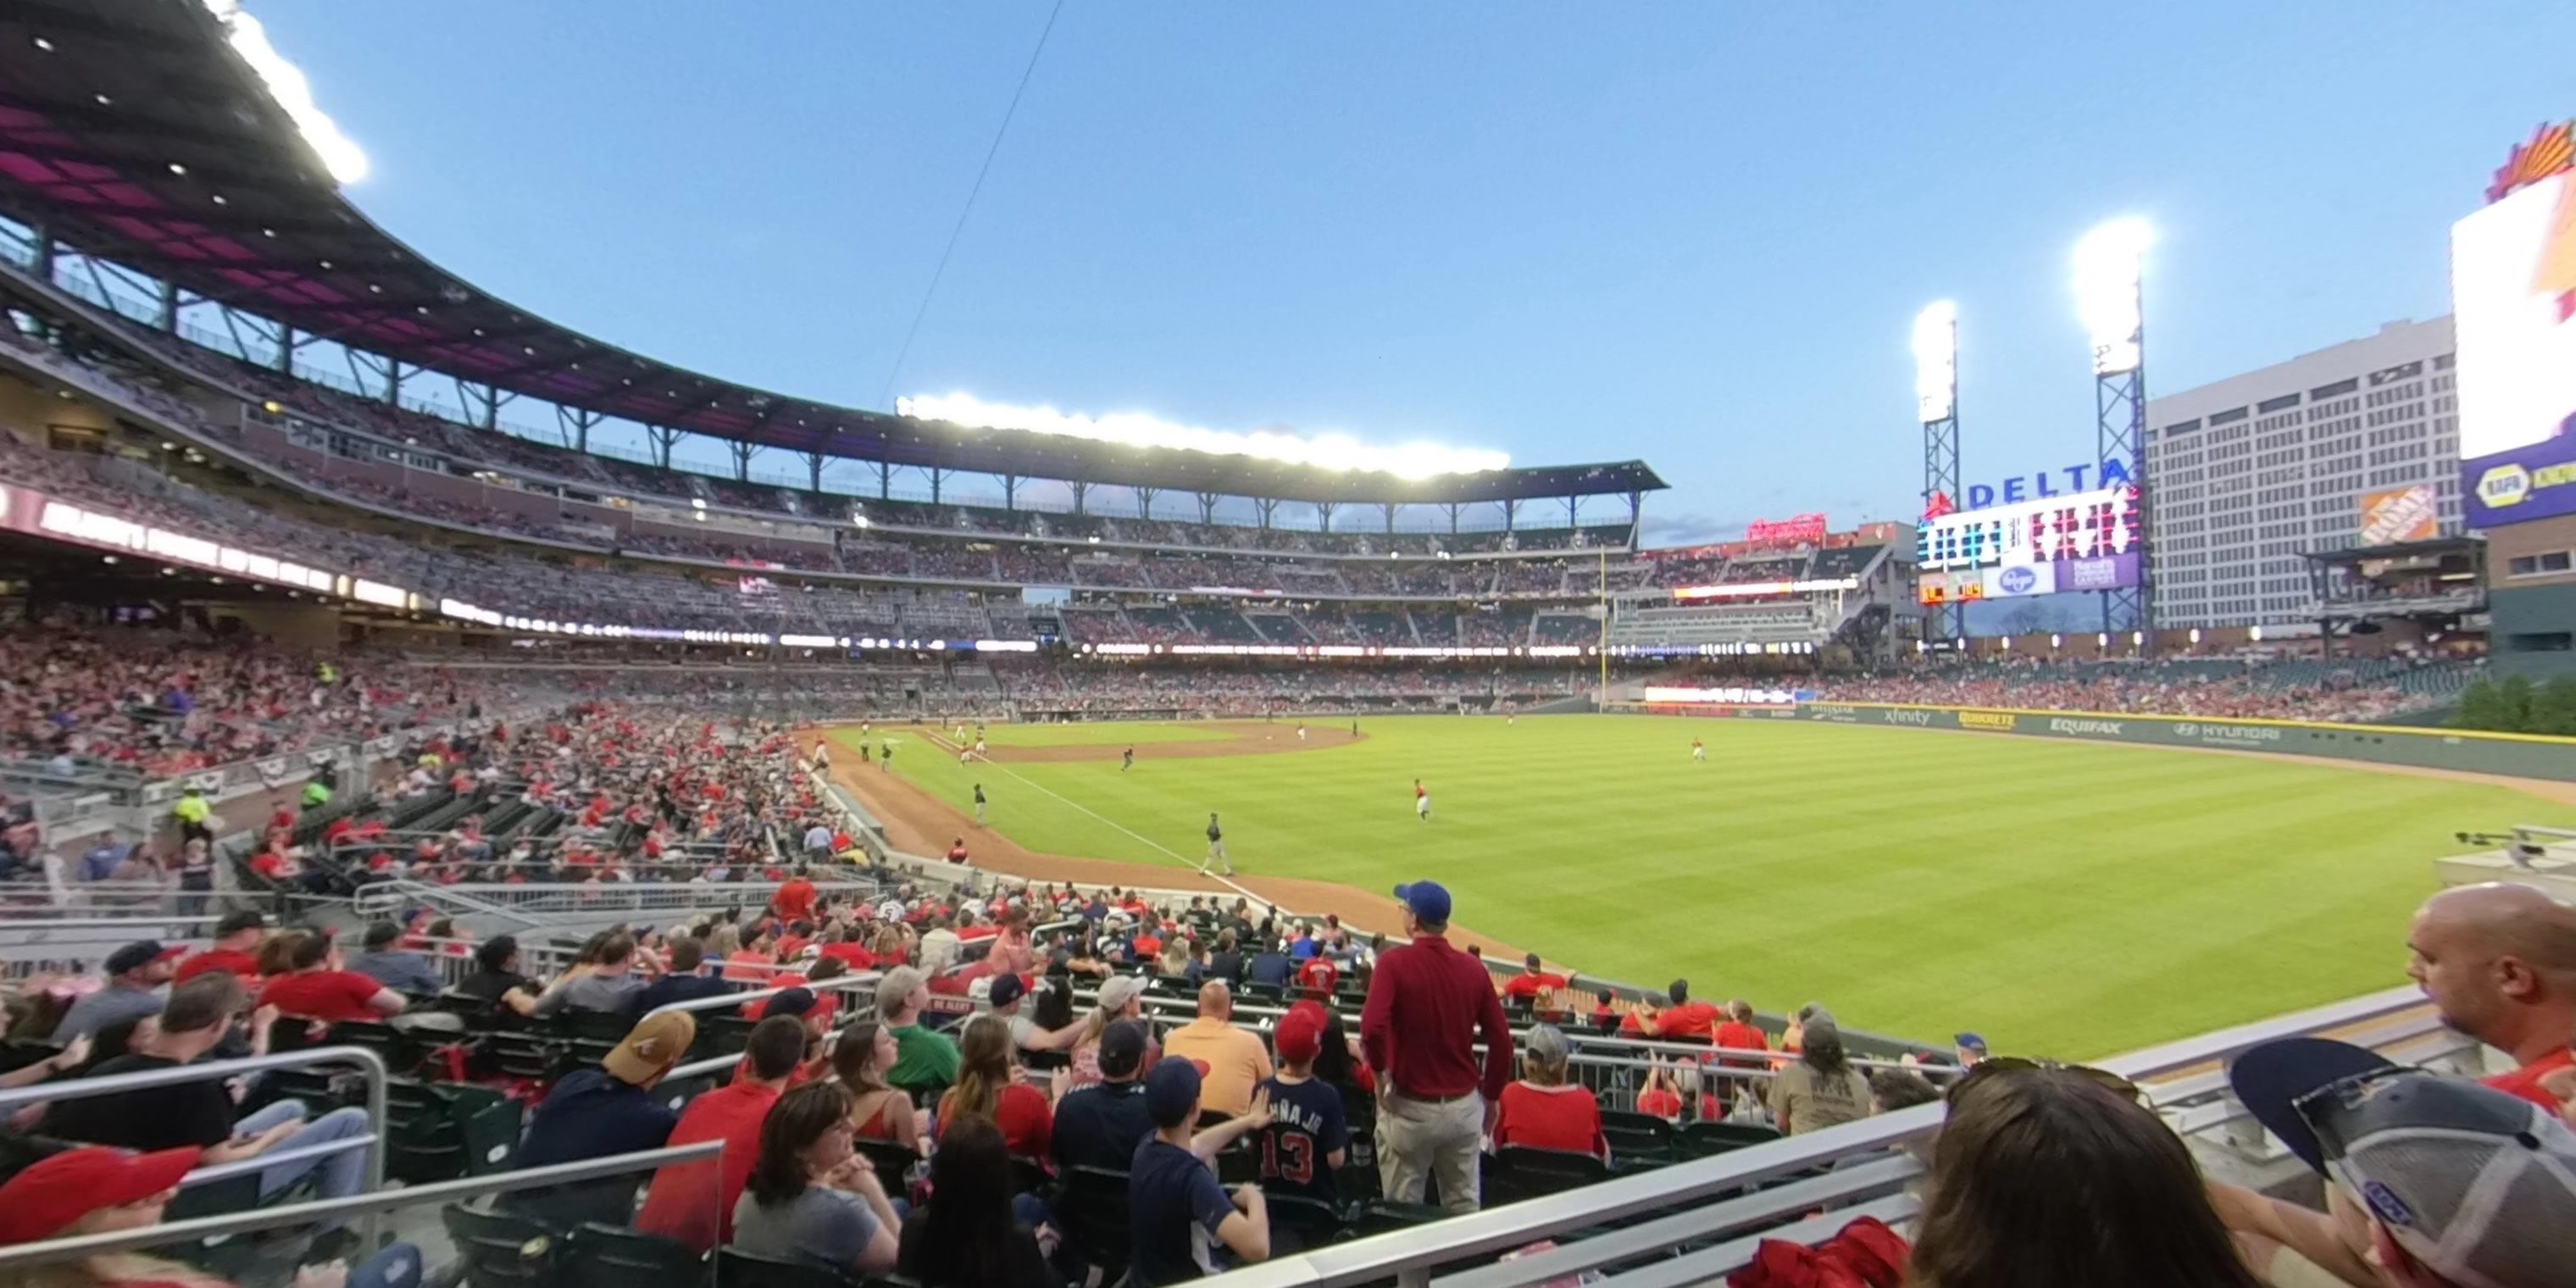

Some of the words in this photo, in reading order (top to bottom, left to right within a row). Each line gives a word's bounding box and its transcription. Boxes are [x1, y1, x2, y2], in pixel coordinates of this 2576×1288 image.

[1968, 458, 2130, 509] DELTA
[1885, 708, 1929, 725] xfinity
[2051, 718, 2121, 735] EQUIFAX
[2203, 724, 2280, 740] HYUNDAI
[1260, 1130, 1313, 1185] 13
